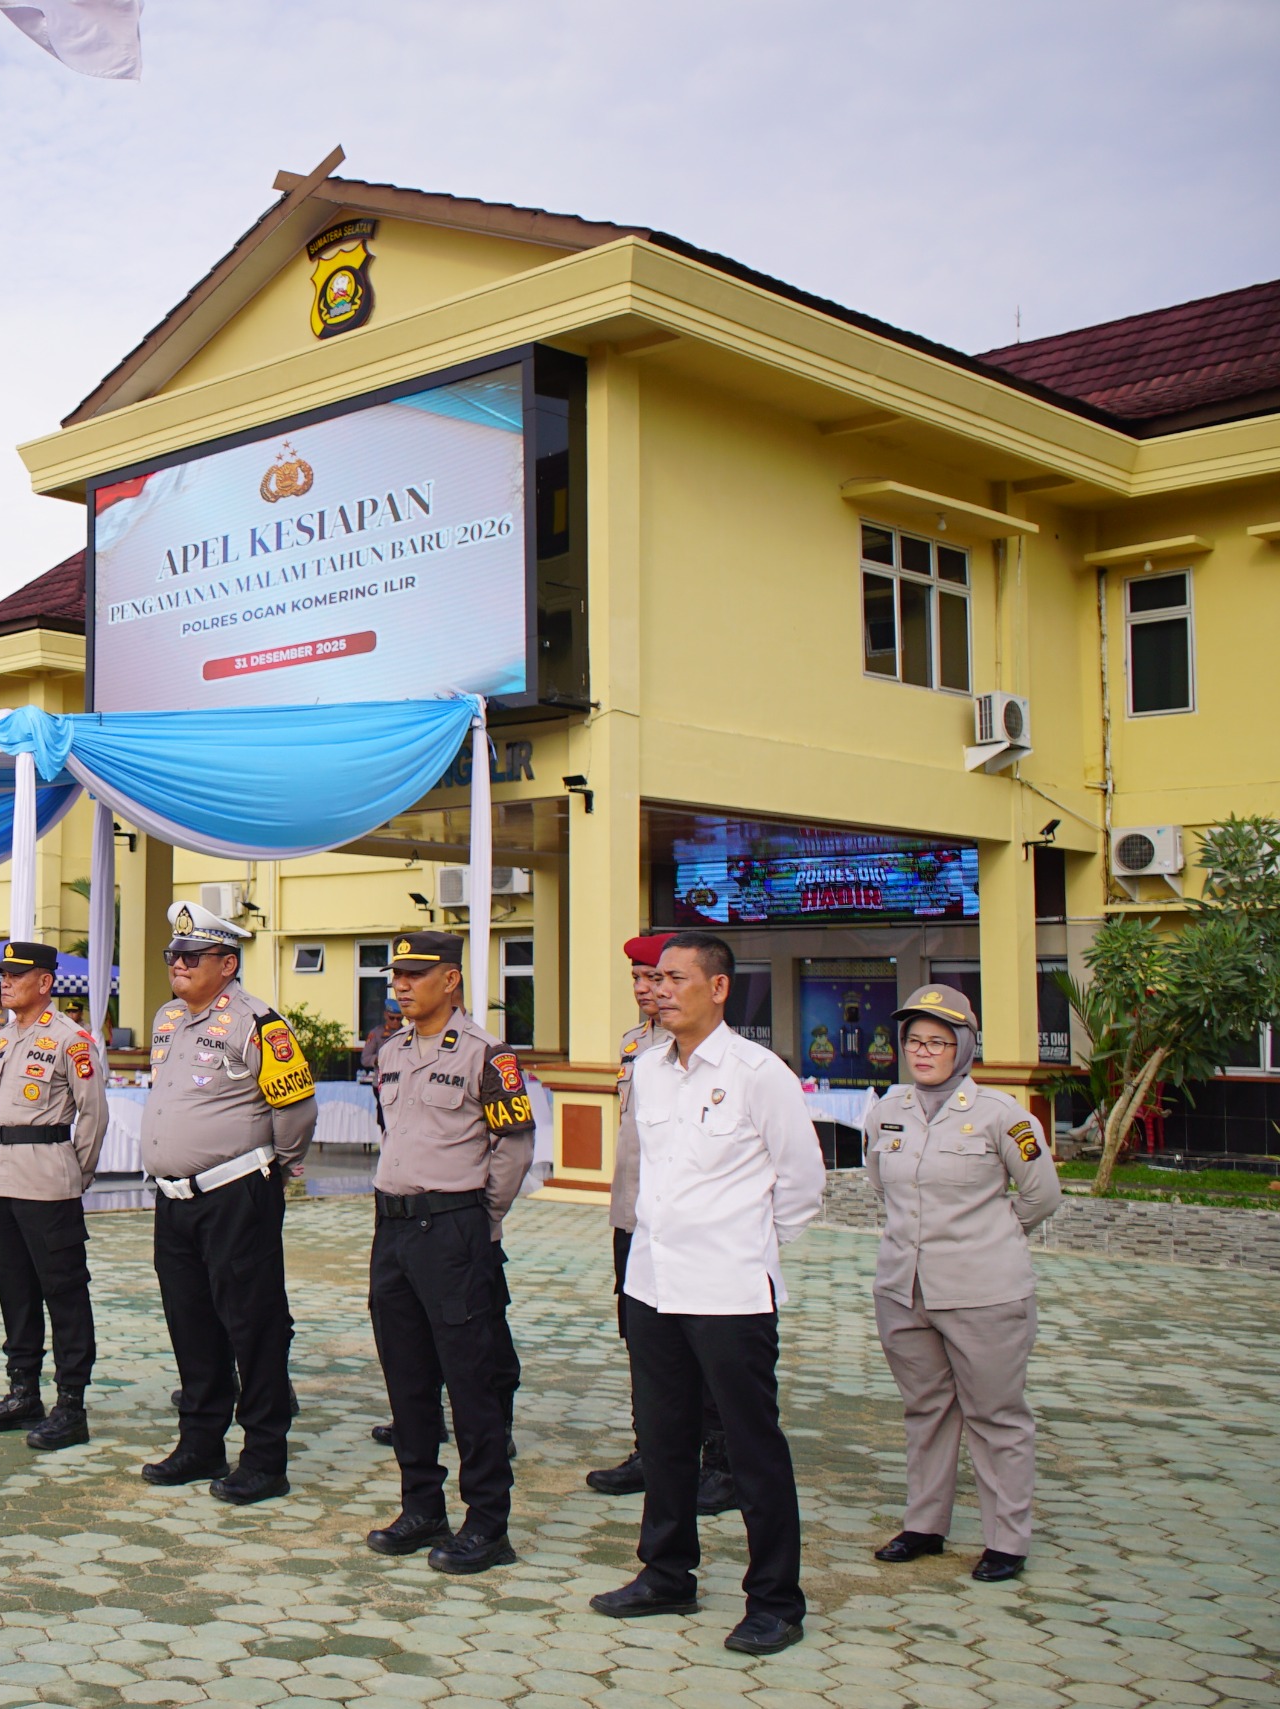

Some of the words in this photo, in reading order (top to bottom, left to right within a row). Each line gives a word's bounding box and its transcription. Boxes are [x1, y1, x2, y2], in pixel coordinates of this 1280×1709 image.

[309, 228, 343, 255] SUMATERA
[343, 222, 372, 237] SELATAN
[158, 533, 240, 580] APEL
[249, 482, 433, 558] KESIAPAN
[110, 578, 232, 623] PENGAMANAN
[235, 564, 308, 595] MALAM
[312, 543, 386, 577] TAHUN
[391, 528, 451, 561] BARU
[457, 516, 512, 545] 2026
[182, 613, 238, 635] POLRES
[242, 602, 287, 623] OGAN
[291, 583, 379, 614] KOMERING
[384, 575, 417, 594] ILIR
[234, 657, 249, 670] 31
[250, 645, 314, 667] DESEMBER
[315, 637, 347, 655] 2025
[795, 867, 855, 886] POLRES
[857, 866, 888, 882] OKI
[801, 885, 883, 912] HADIR
[153, 1034, 171, 1044] OKE
[196, 1036, 225, 1050] POLRI
[1050, 1032, 1068, 1046] OKI
[26, 1050, 56, 1065] POLRI
[264, 1067, 313, 1103] KASATGAS
[429, 1072, 465, 1088] POLRI
[484, 1100, 513, 1130] KA
